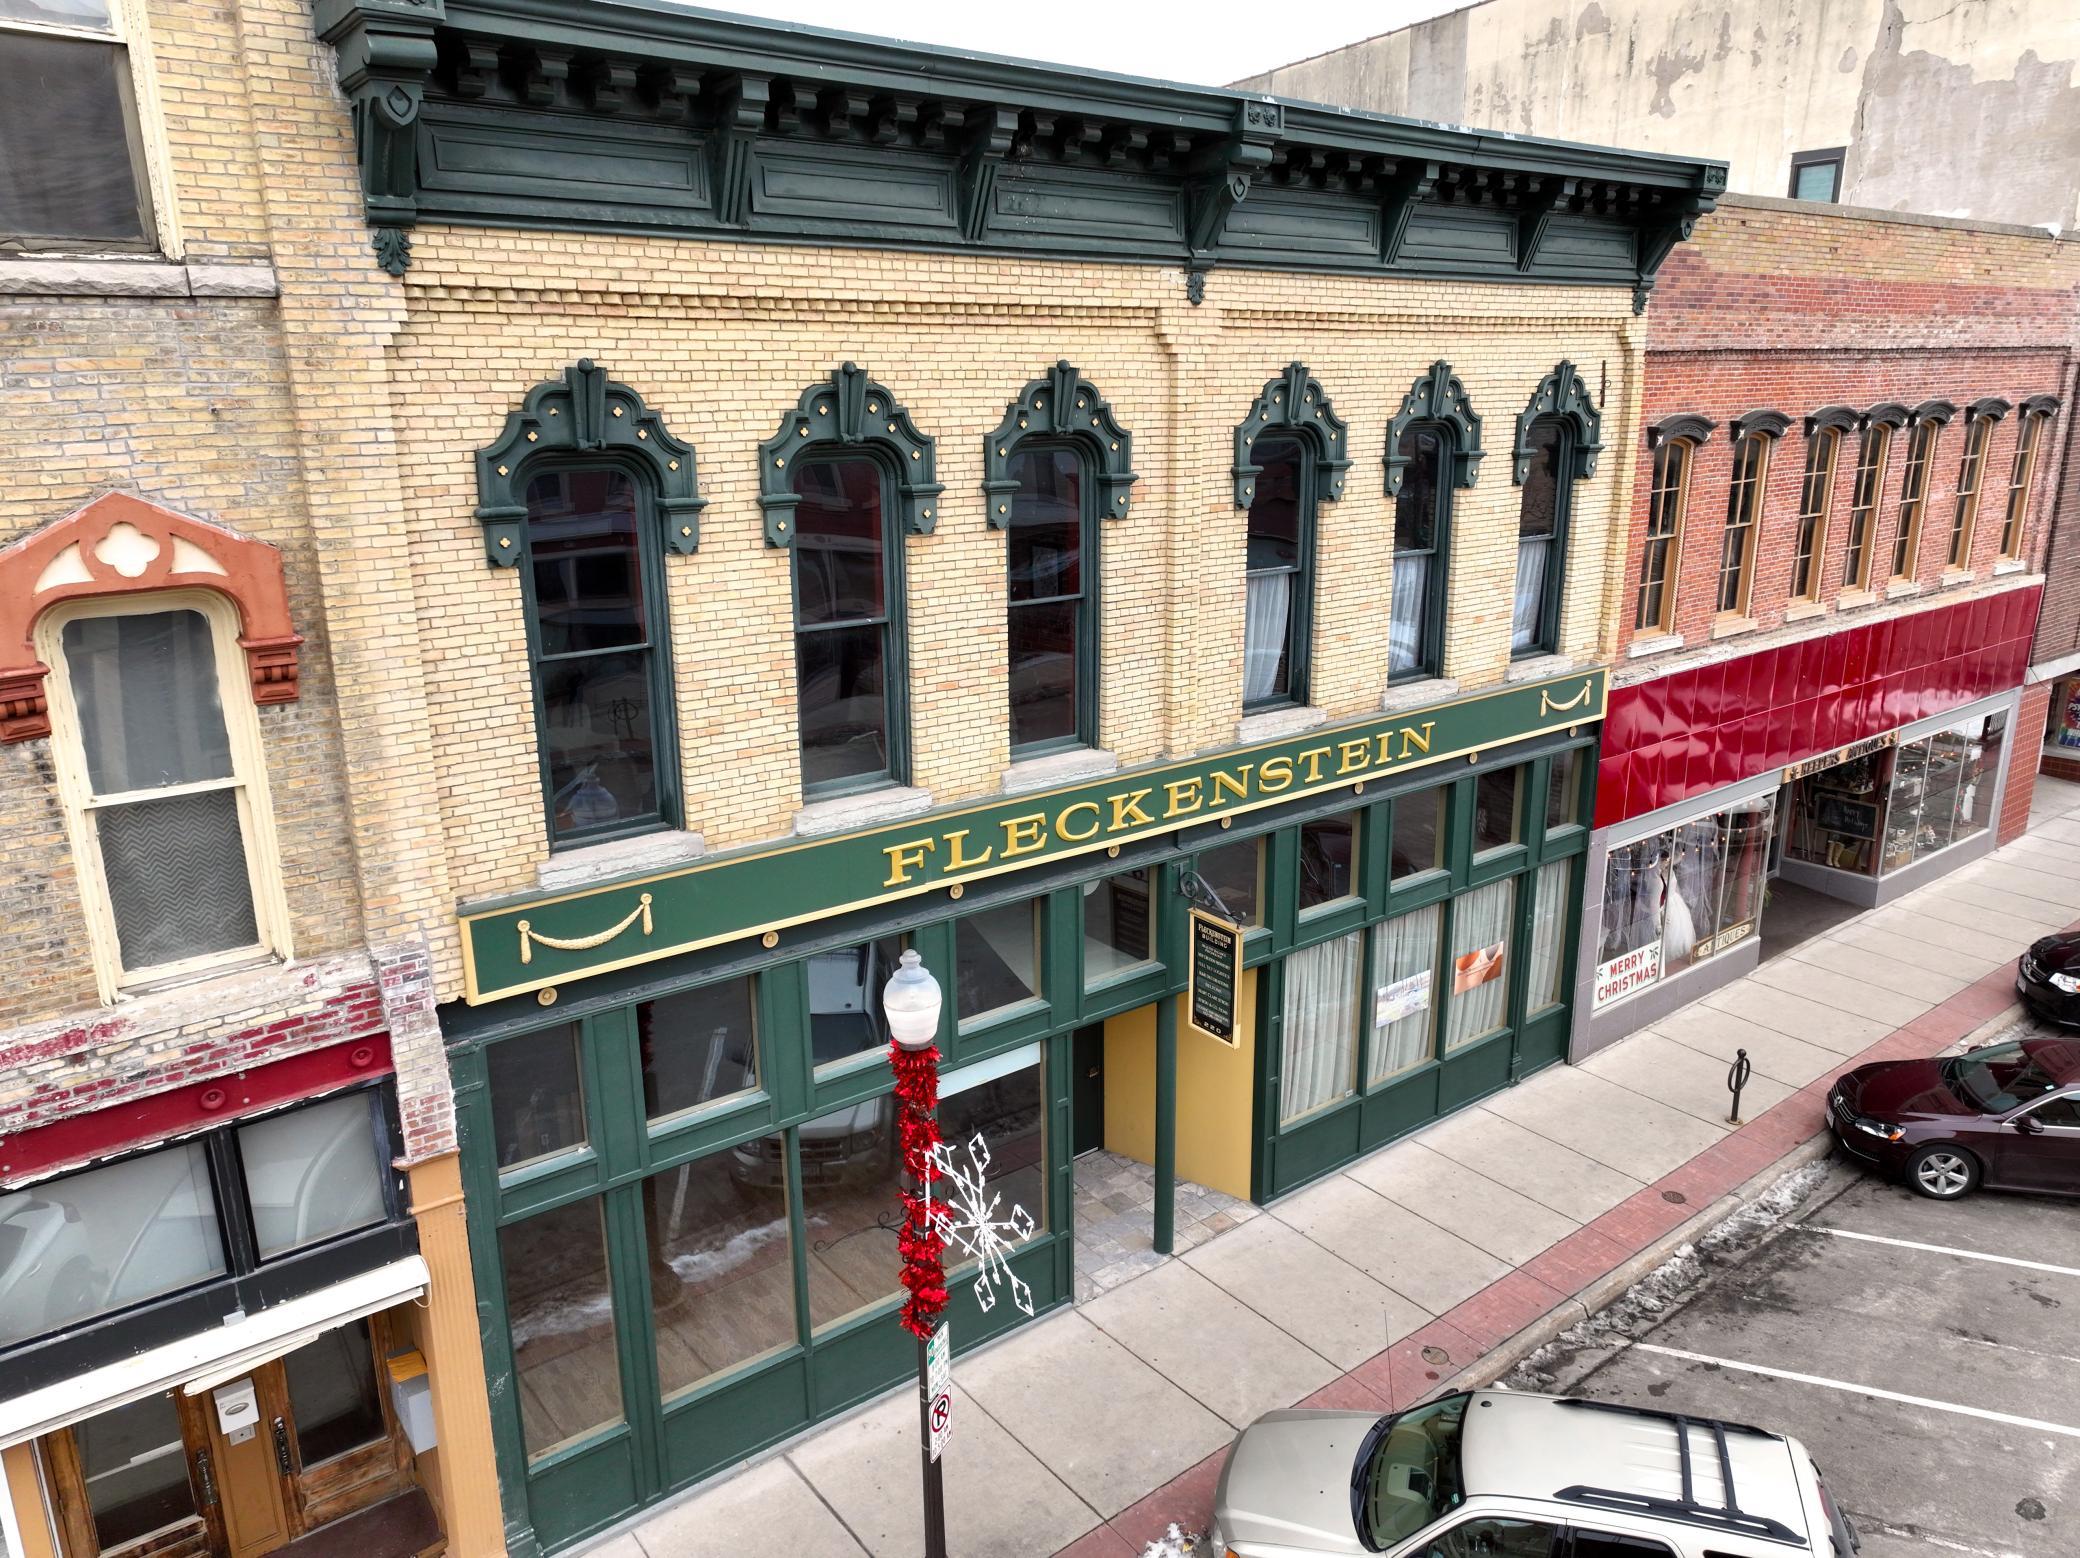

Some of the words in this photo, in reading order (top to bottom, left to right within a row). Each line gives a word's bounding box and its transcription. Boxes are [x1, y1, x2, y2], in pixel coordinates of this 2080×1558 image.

[882, 721, 1436, 888] FLECKENSTEIN
[1198, 923, 1231, 944] FLECKENSTEIN
[1201, 933, 1228, 949] BUILDING
[1702, 925, 1746, 953] ATIQUES
[1609, 950, 1644, 977] MERRY
[1597, 962, 1657, 1002] CHRISTMAS
[1203, 1021, 1221, 1034] 220
